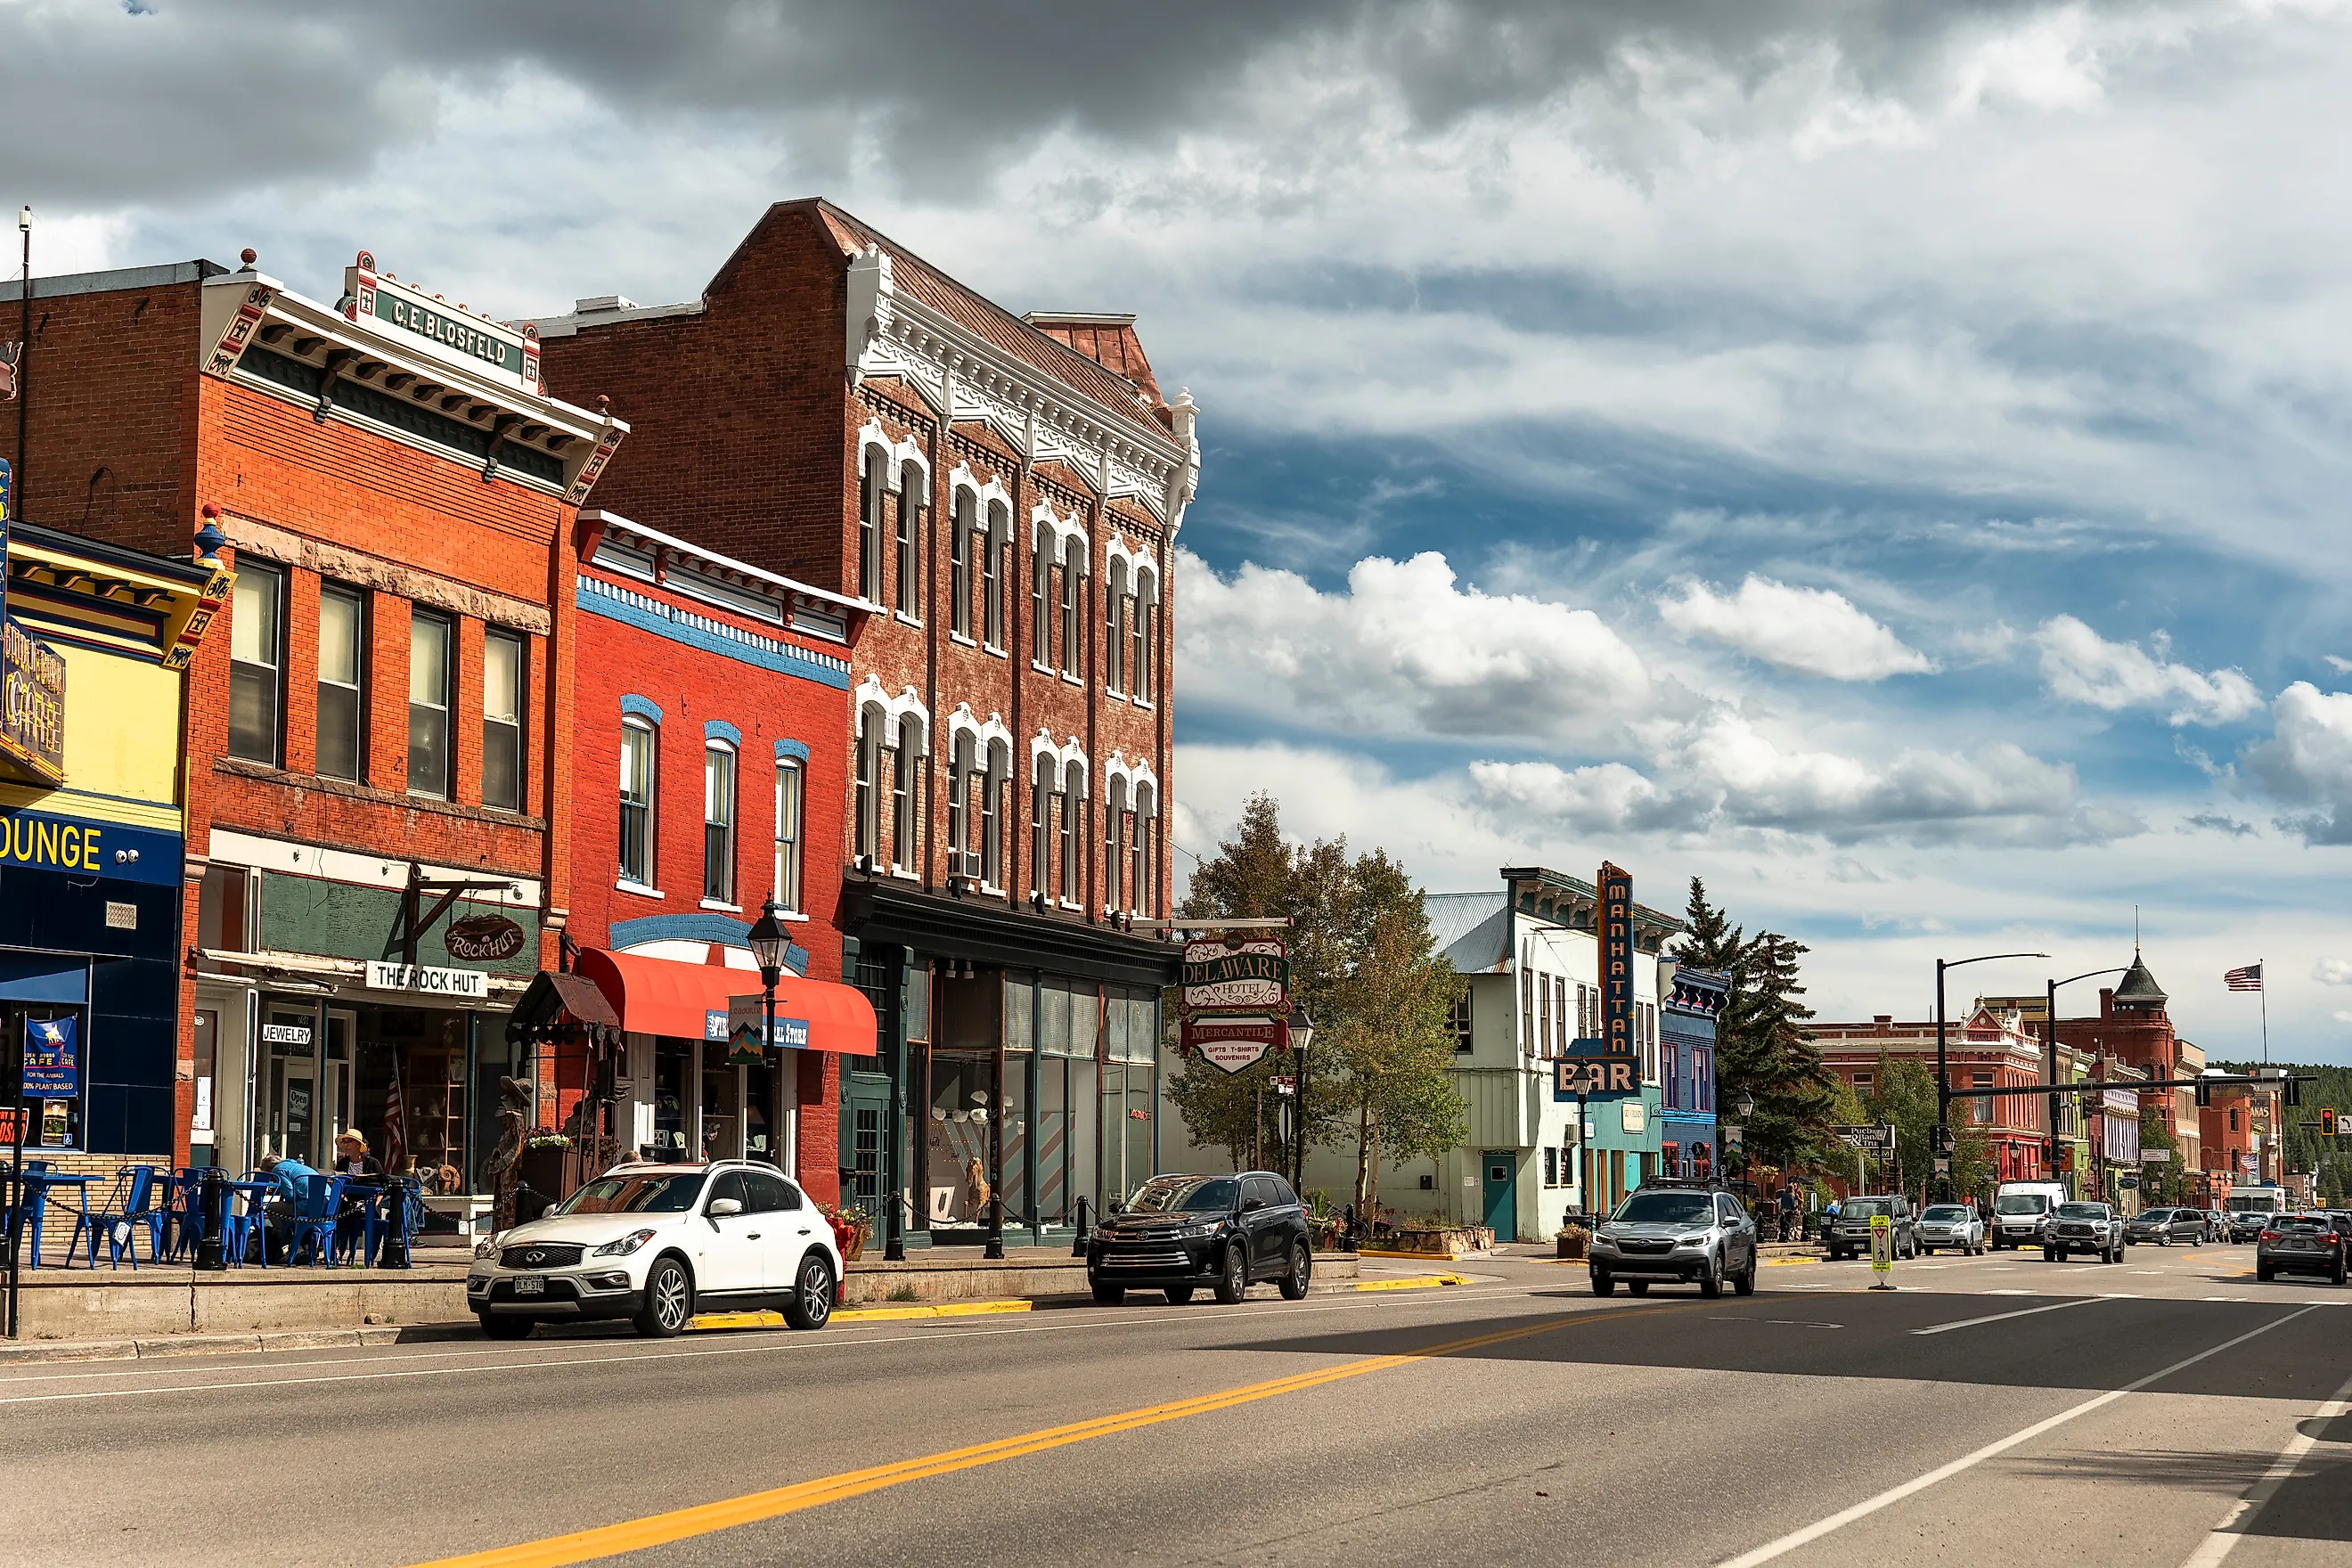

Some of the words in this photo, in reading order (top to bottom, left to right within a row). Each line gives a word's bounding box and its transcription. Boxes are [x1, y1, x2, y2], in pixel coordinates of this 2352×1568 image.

[5, 671, 62, 754] CAFE
[0, 817, 102, 870] OUNGE
[447, 929, 459, 939] THE
[1181, 957, 1283, 984] DELAWARE
[1608, 884, 1627, 1052] MANHATTAN
[378, 966, 406, 986] THE
[409, 968, 449, 991] ROCK
[453, 973, 479, 992] HUT
[1222, 983, 1264, 994] HOTEL
[264, 1026, 311, 1043] JEWELRY
[1190, 1026, 1275, 1040] MERCANTILE
[1558, 1063, 1634, 1091] BAR
[22, 1082, 35, 1090] 00%
[35, 1082, 53, 1090] PLANT
[53, 1082, 74, 1090] BASED
[290, 1090, 307, 1105] Open
[2250, 1107, 2269, 1118] ANAS
[654, 1131, 668, 1147] PEN
[1850, 1133, 1864, 1147] &
